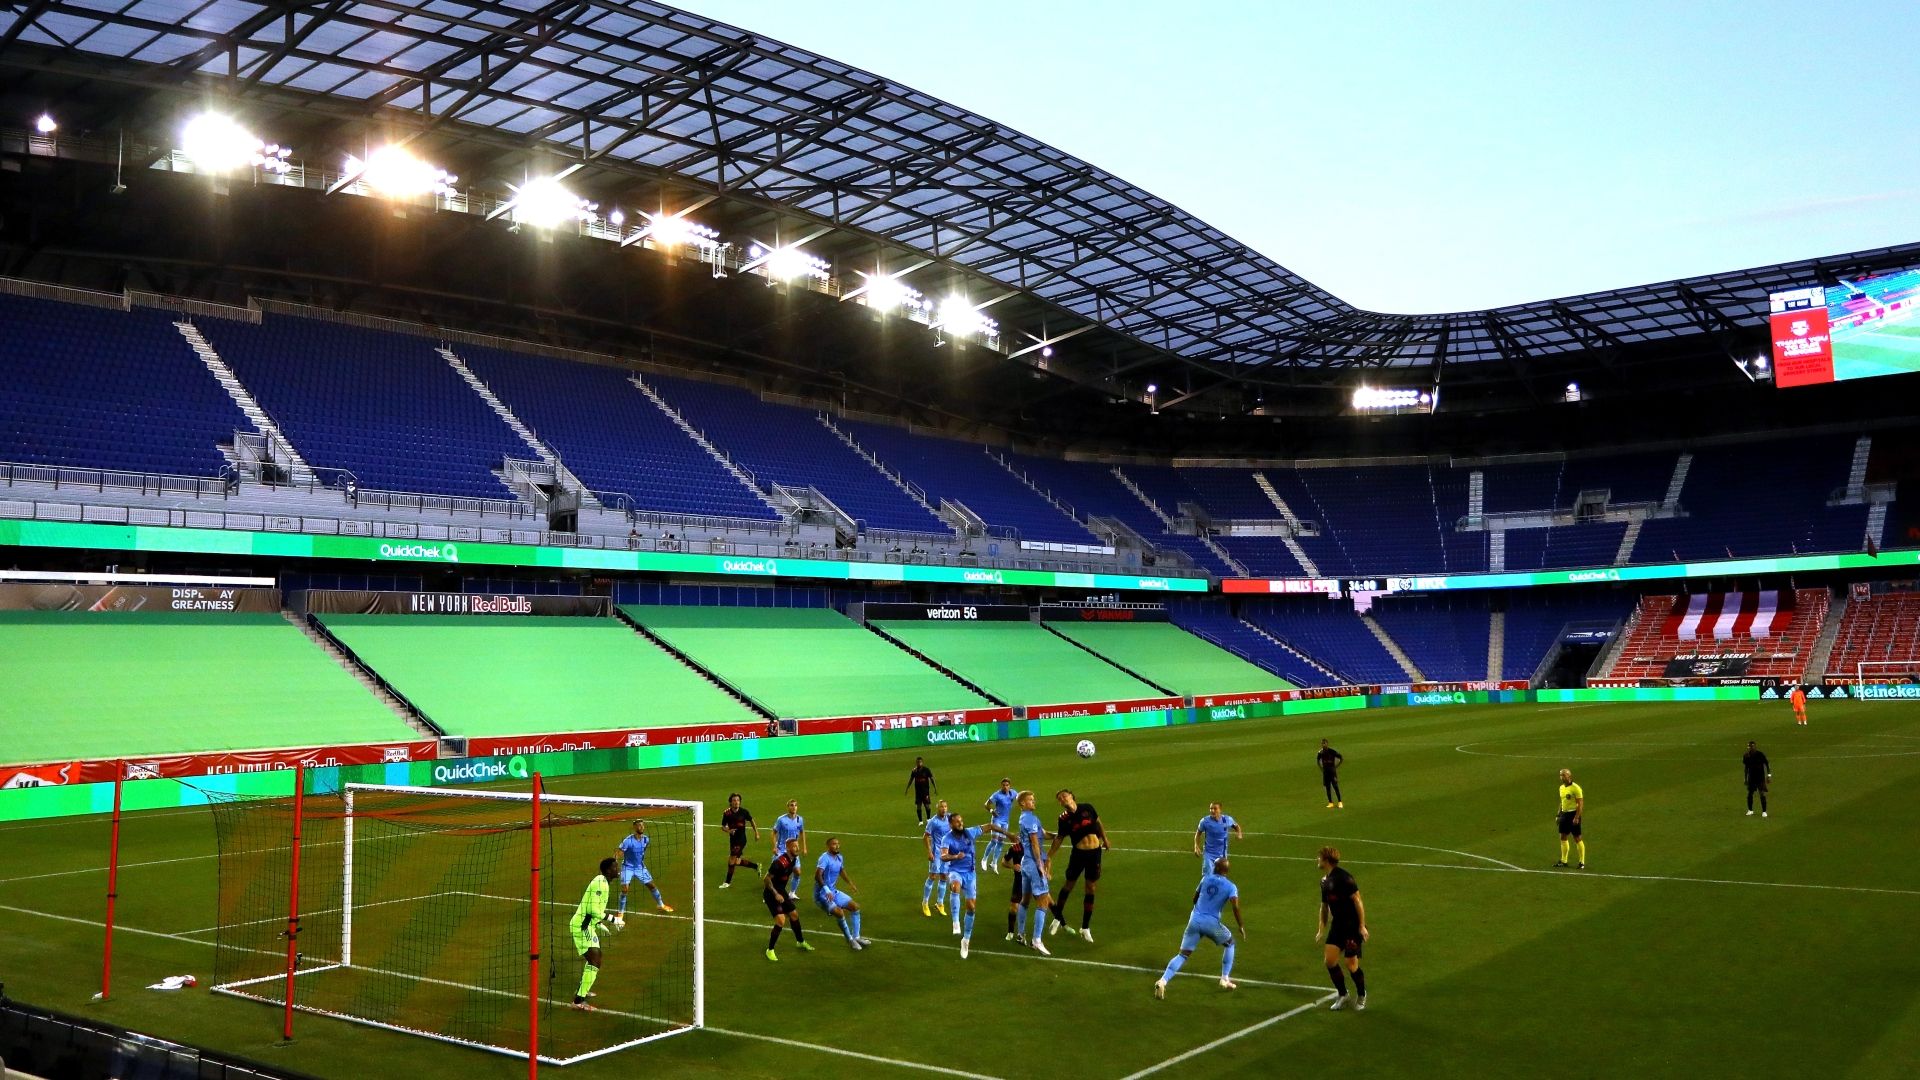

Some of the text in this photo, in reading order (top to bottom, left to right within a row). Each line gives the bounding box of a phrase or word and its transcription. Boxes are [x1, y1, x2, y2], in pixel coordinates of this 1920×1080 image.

[380, 544, 440, 558] QuickChek
[724, 560, 765, 573] QuickChek
[1348, 580, 1377, 591] 36:00
[171, 600, 234, 610] GREATNESS
[411, 594, 435, 612] NEW
[439, 594, 468, 612] YORK
[926, 606, 978, 619] verizon 5G
[1467, 682, 1500, 691] EMPIRE
[1413, 694, 1453, 704] QuickChek
[927, 728, 968, 743] QuickChek
[1206, 883, 1219, 902] 9
